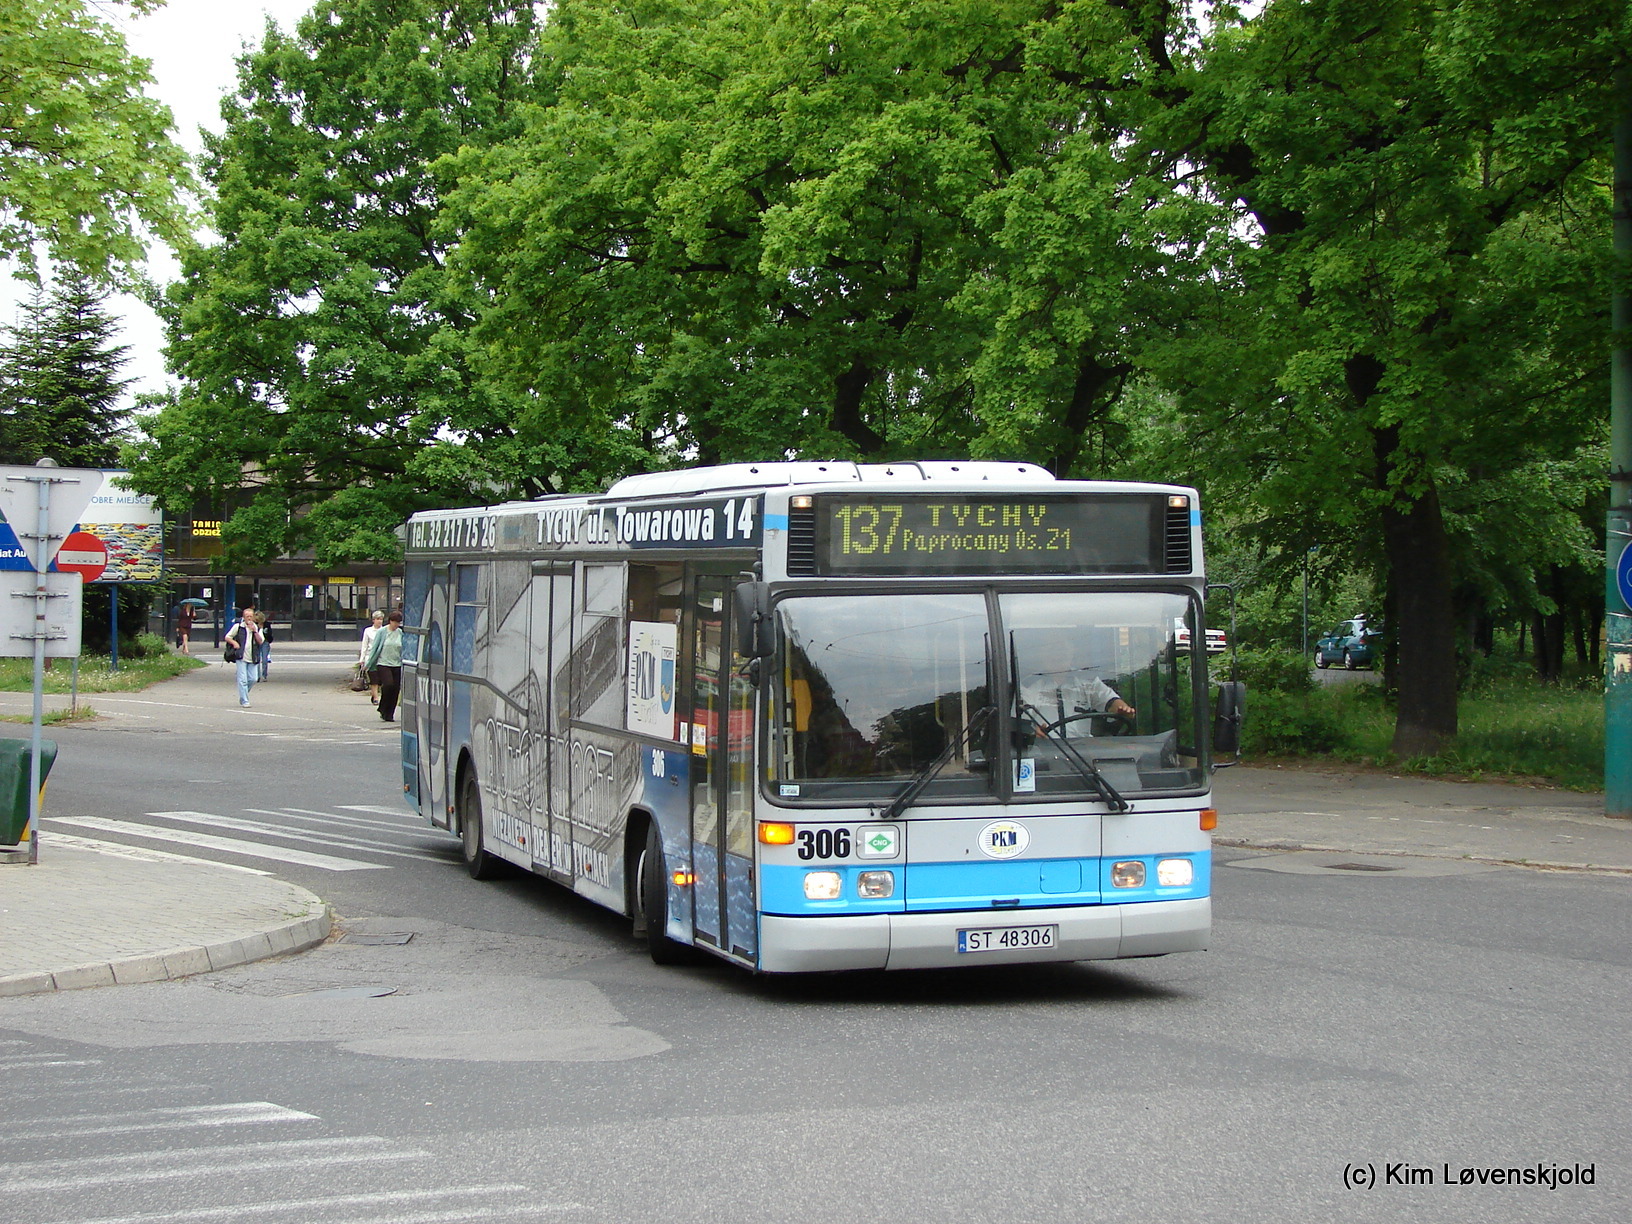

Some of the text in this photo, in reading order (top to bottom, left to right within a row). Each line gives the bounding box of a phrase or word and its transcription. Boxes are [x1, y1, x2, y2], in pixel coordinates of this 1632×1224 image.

[91, 496, 151, 505] OBRE MIEJSCE
[537, 497, 754, 544] TYCHY ul. Towarowa 14
[835, 505, 902, 553] 137
[927, 505, 1046, 526] TYCHY
[412, 516, 496, 548] tel. 32 217 75 26
[903, 528, 1009, 553] Paprocany
[0, 548, 27, 558] iat Au
[652, 748, 665, 778] 306
[533, 825, 562, 869] DEAER
[797, 828, 851, 860] 306
[992, 830, 1017, 847] PKM
[969, 928, 1051, 949] ST 48306
